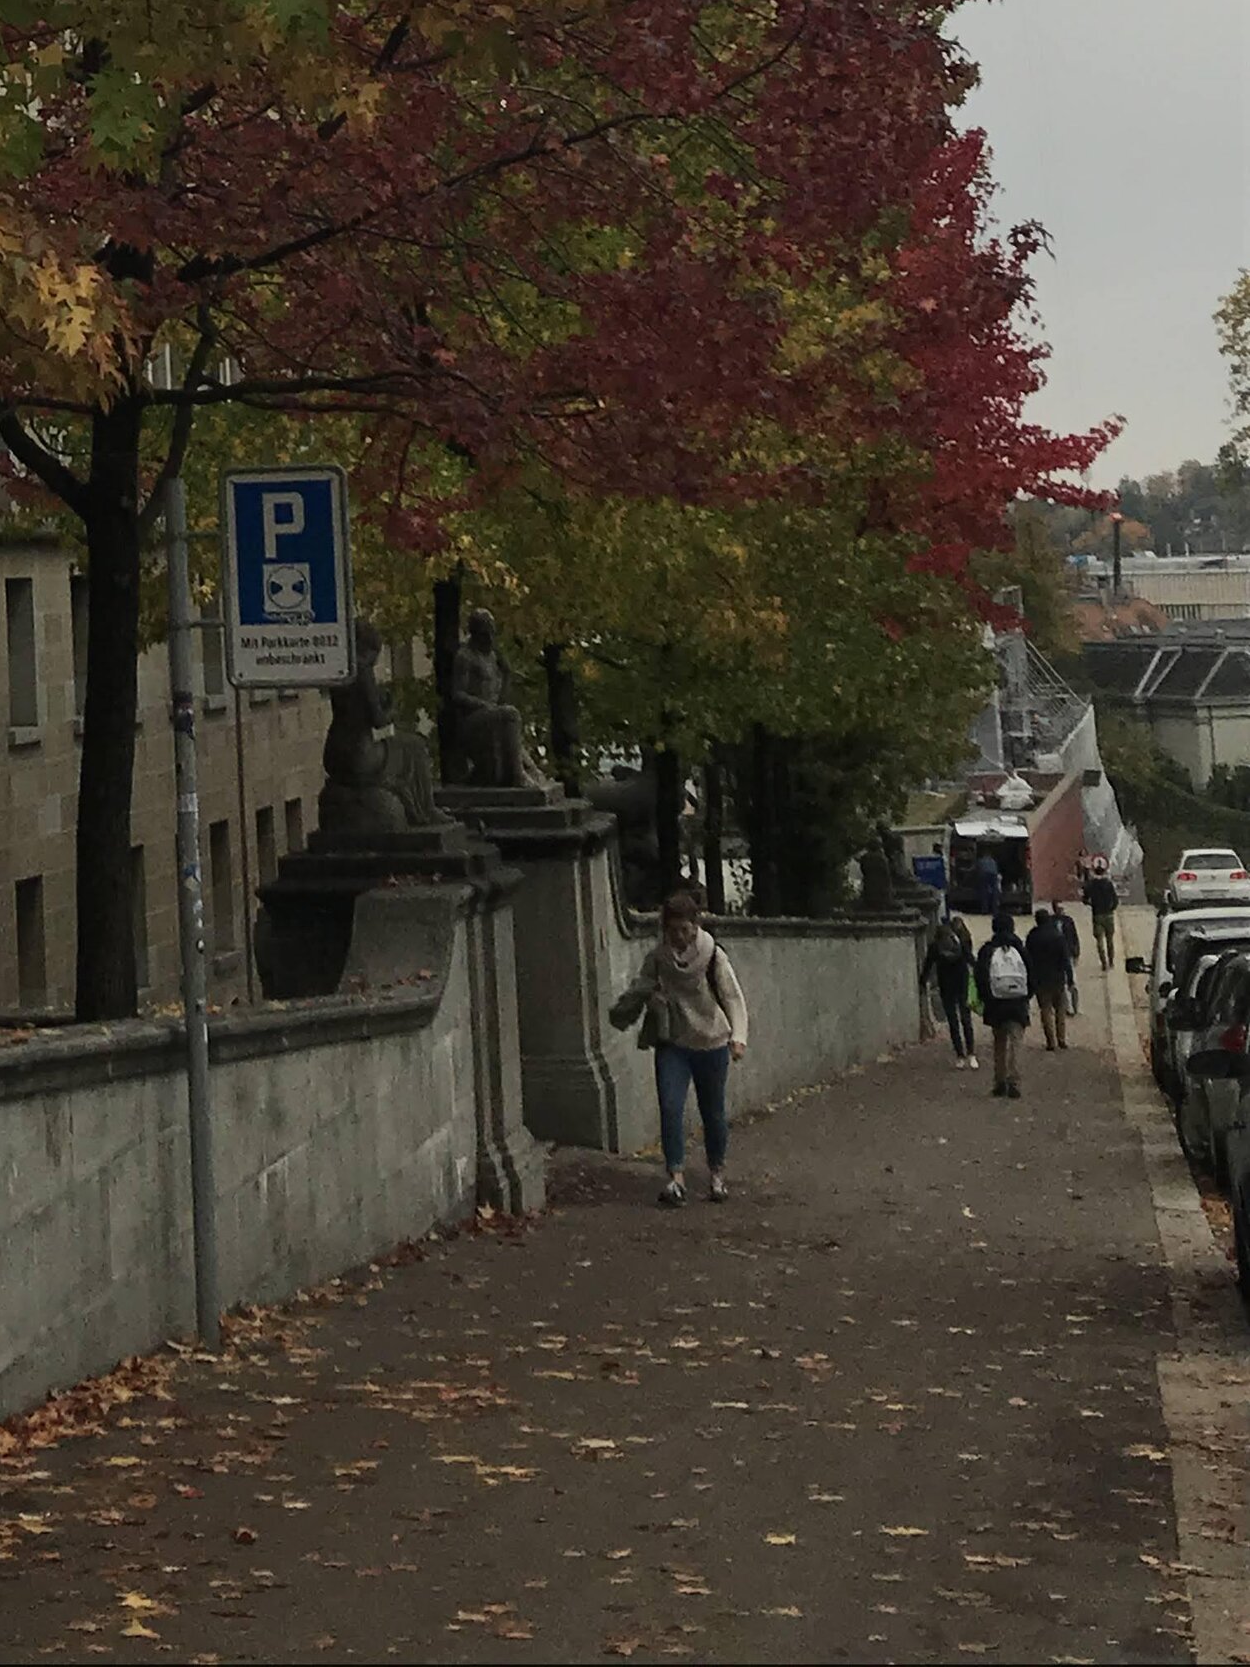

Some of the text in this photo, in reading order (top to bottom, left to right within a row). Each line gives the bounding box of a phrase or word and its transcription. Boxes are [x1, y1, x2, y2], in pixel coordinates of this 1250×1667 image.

[262, 491, 305, 559] P
[241, 637, 258, 648] Mit
[261, 636, 310, 648] Parkkarte
